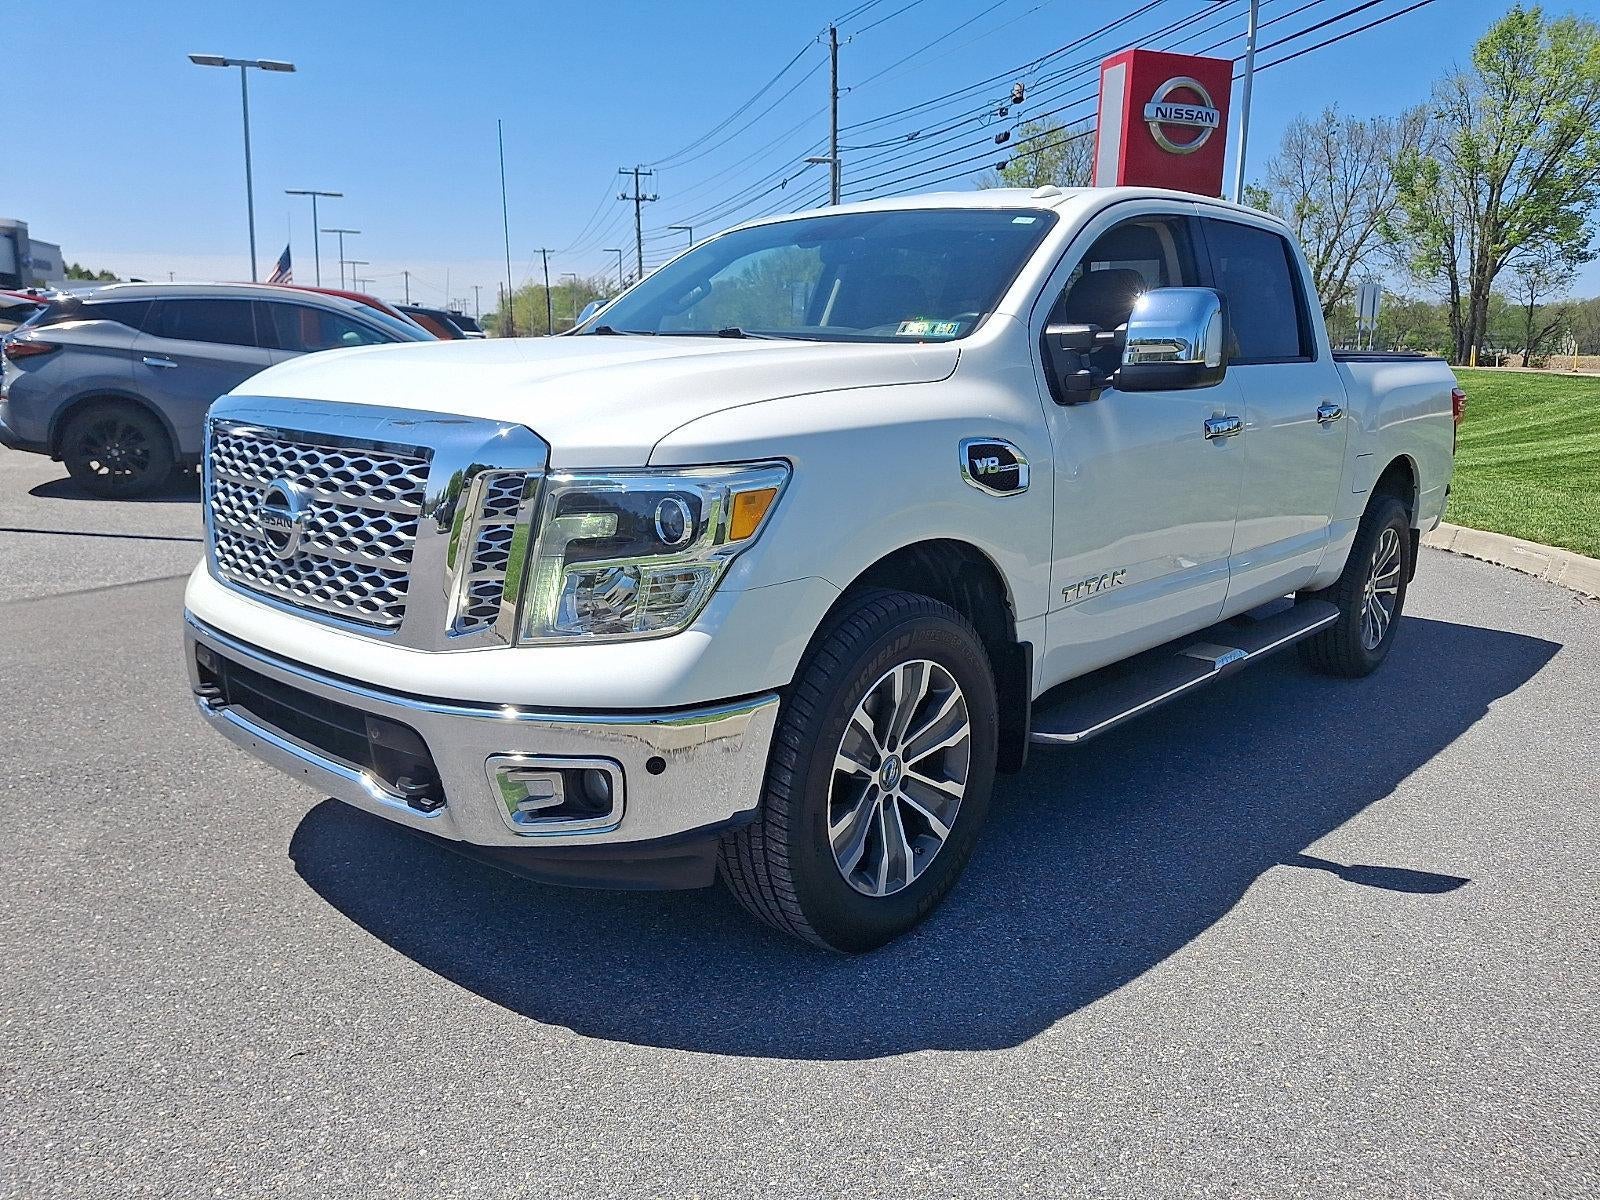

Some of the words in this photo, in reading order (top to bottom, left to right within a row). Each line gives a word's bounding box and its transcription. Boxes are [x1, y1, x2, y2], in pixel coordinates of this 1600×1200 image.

[1155, 107, 1215, 123] NISSAN
[970, 456, 999, 475] V8
[261, 512, 293, 529] SSAN
[1062, 568, 1127, 603] TITAN
